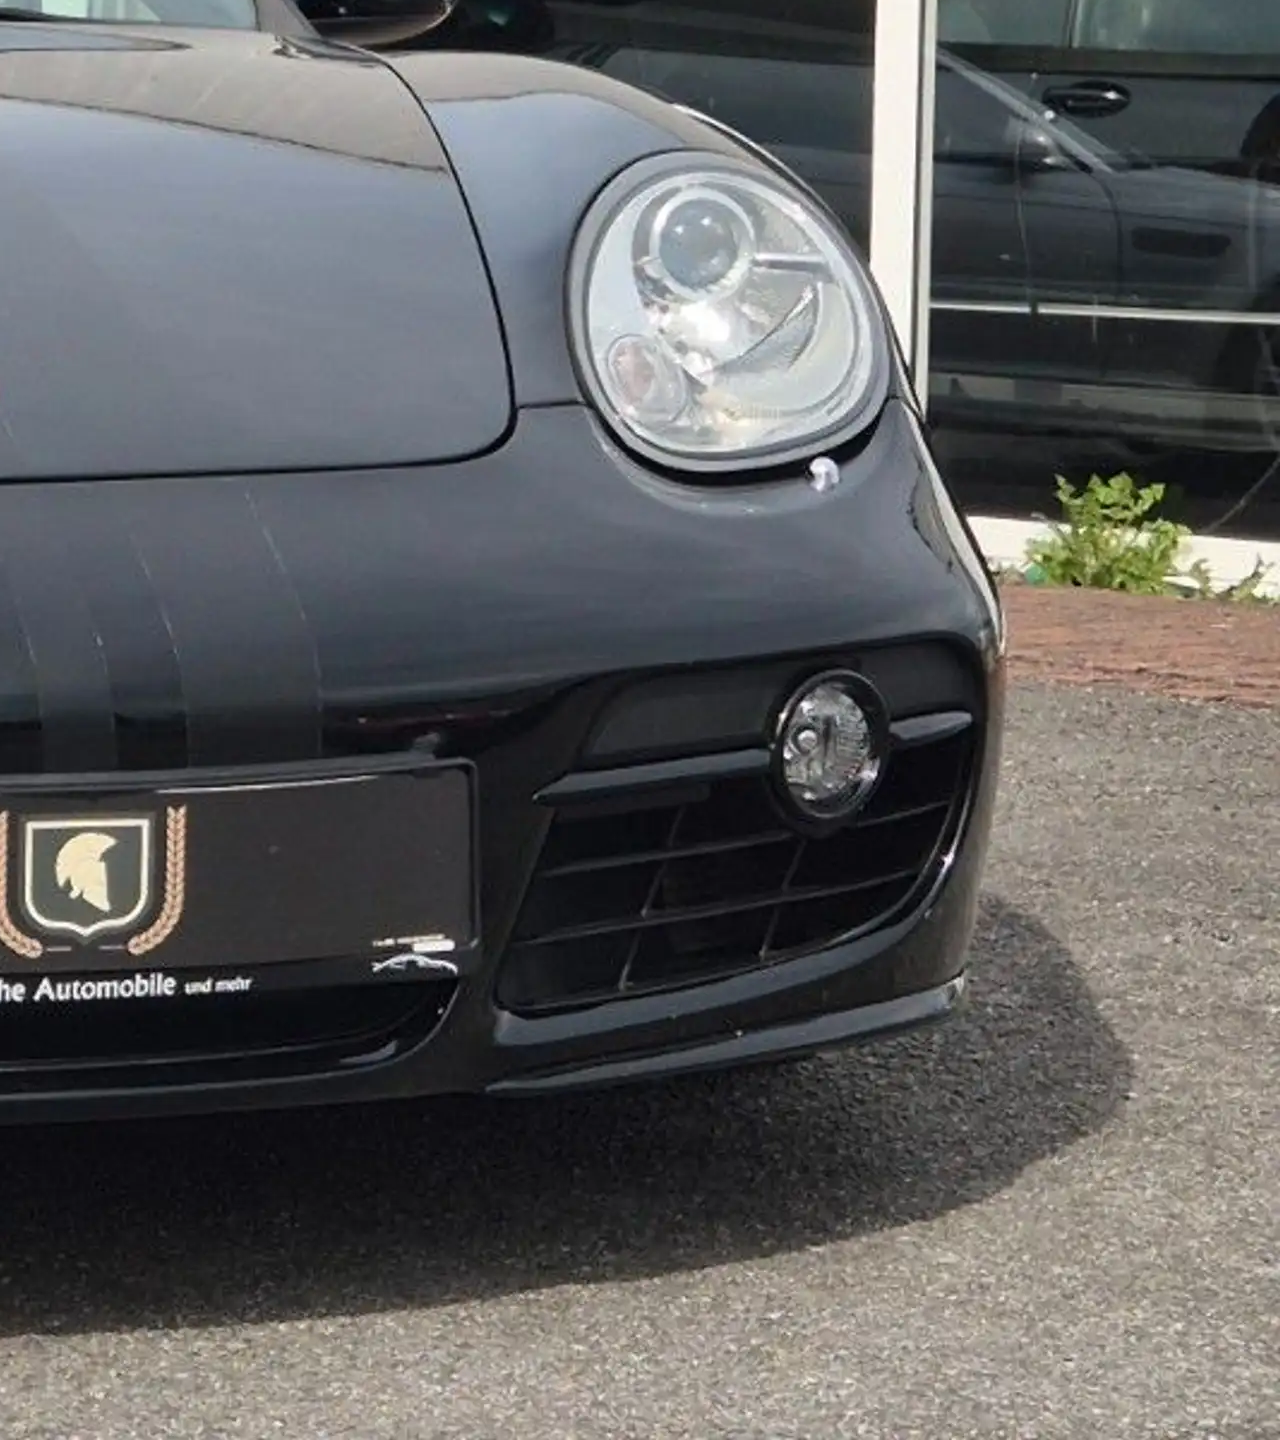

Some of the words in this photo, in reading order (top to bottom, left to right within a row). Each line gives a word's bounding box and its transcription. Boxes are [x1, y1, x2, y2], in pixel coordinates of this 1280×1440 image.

[33, 972, 177, 1001] Automobile
[185, 976, 213, 995] und
[215, 975, 253, 992] mehr
